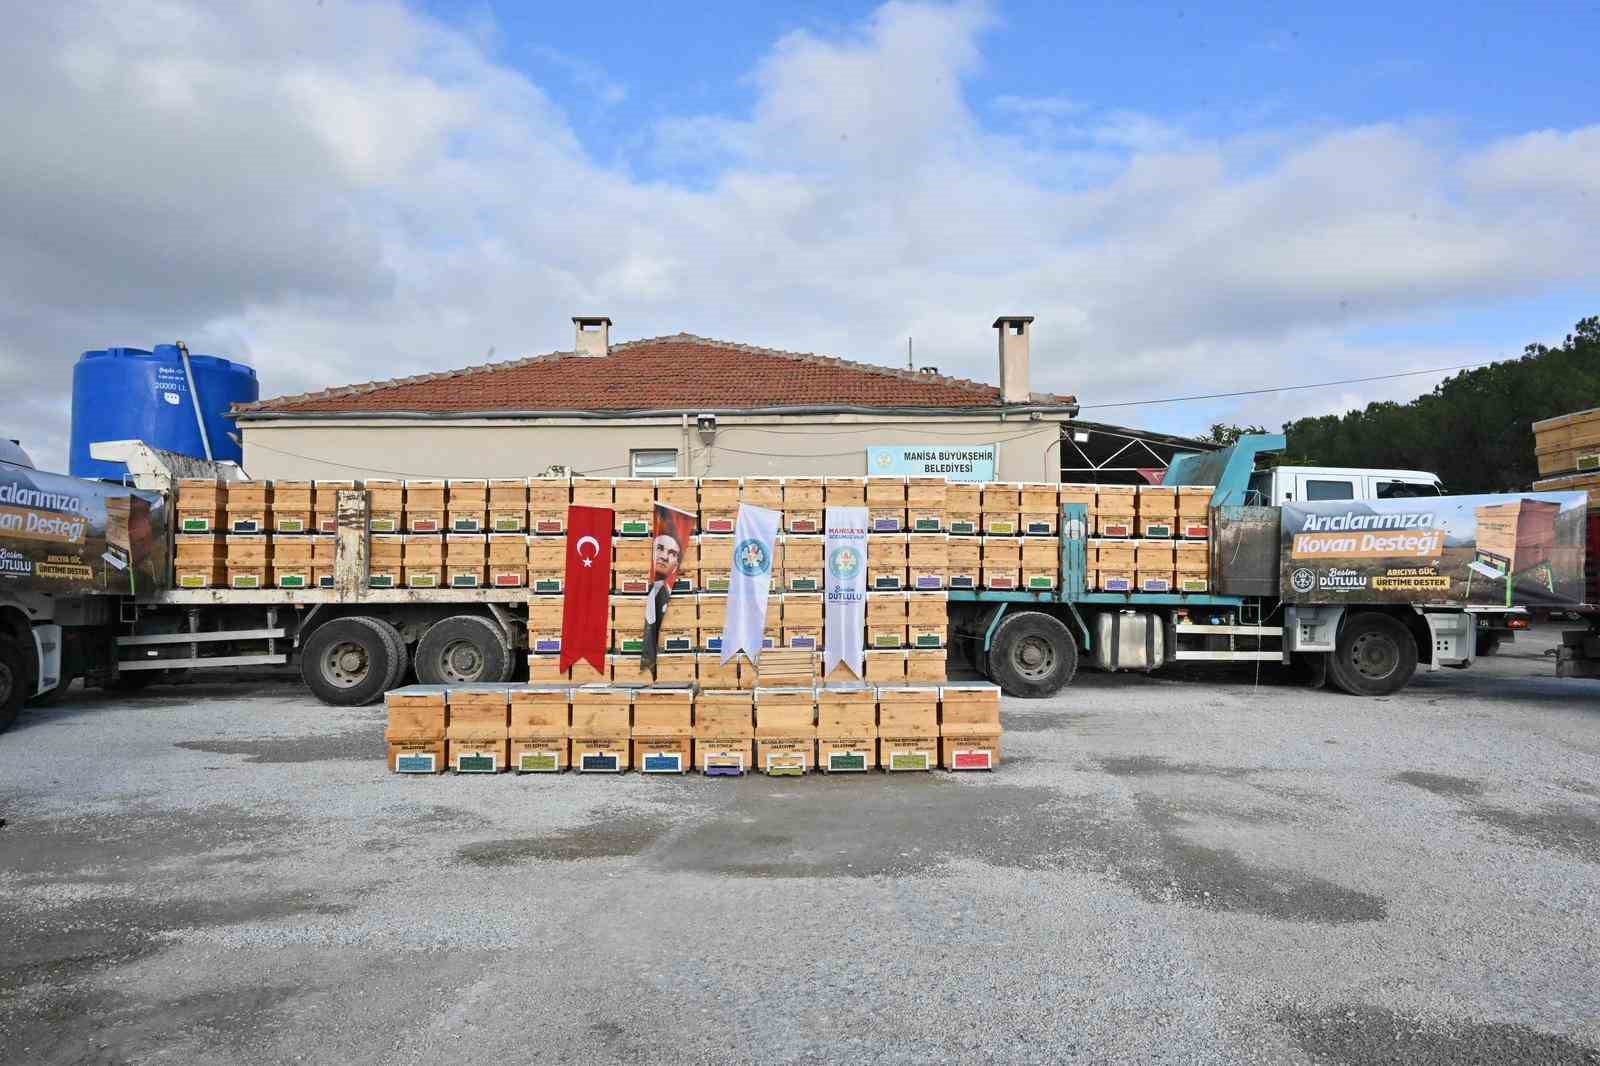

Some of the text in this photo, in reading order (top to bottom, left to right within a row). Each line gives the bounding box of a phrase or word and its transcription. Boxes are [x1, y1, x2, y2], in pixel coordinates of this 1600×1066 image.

[904, 450, 993, 462] MANİSA BÜYÜKŞEHİR
[924, 463, 973, 473] BELEDİYESİ
[1302, 511, 1434, 531] Arıcılarımıza
[25, 512, 86, 543] Desteği
[1296, 531, 1441, 556] Kovan Desteği
[1328, 567, 1358, 577] Besim
[1320, 576, 1367, 586] DUTLULU
